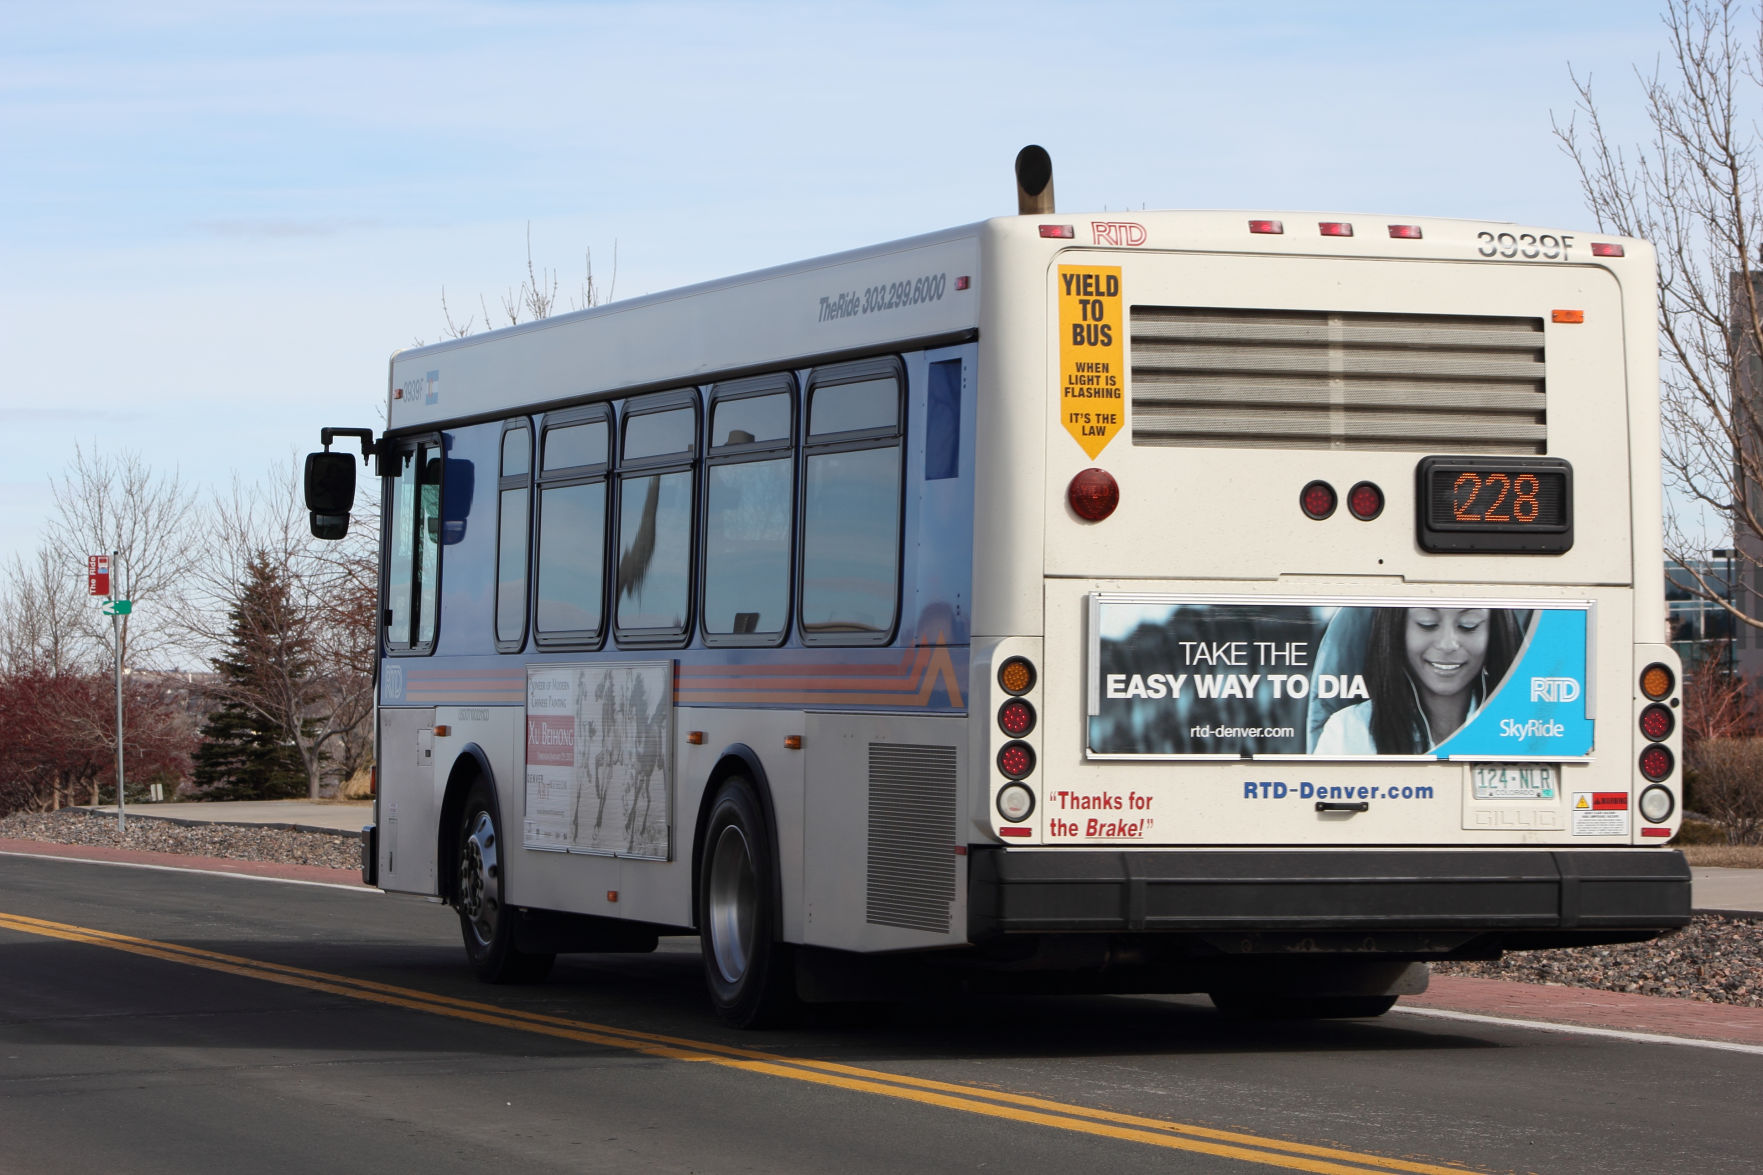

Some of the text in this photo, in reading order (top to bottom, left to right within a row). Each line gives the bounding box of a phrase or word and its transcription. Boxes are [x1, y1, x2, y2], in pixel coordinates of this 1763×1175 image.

[1091, 221, 1148, 246] RTD
[1477, 231, 1575, 261] 3939F
[818, 272, 946, 322] TheRide 303.299.6000
[1061, 273, 1119, 297] YIELD
[1078, 298, 1104, 322] TO
[1072, 323, 1113, 347] BUS
[1075, 362, 1110, 374] WHEN
[1068, 374, 1117, 387] LIGHT IS
[1064, 387, 1121, 399] FLASHING
[1069, 412, 1117, 425] IT'S THE
[1082, 425, 1106, 437] LAW
[1453, 472, 1540, 522] 228
[1179, 641, 1308, 666] TAKE THE
[1106, 674, 1370, 699] EASY WAY TO DIA
[1530, 677, 1581, 703] RTD
[1190, 724, 1295, 738] rtd-denver.com
[1499, 718, 1565, 742] SkyRide
[1128, 791, 1154, 810] for
[1244, 781, 1434, 799] RTD-Denver.com
[1050, 818, 1079, 837] the
